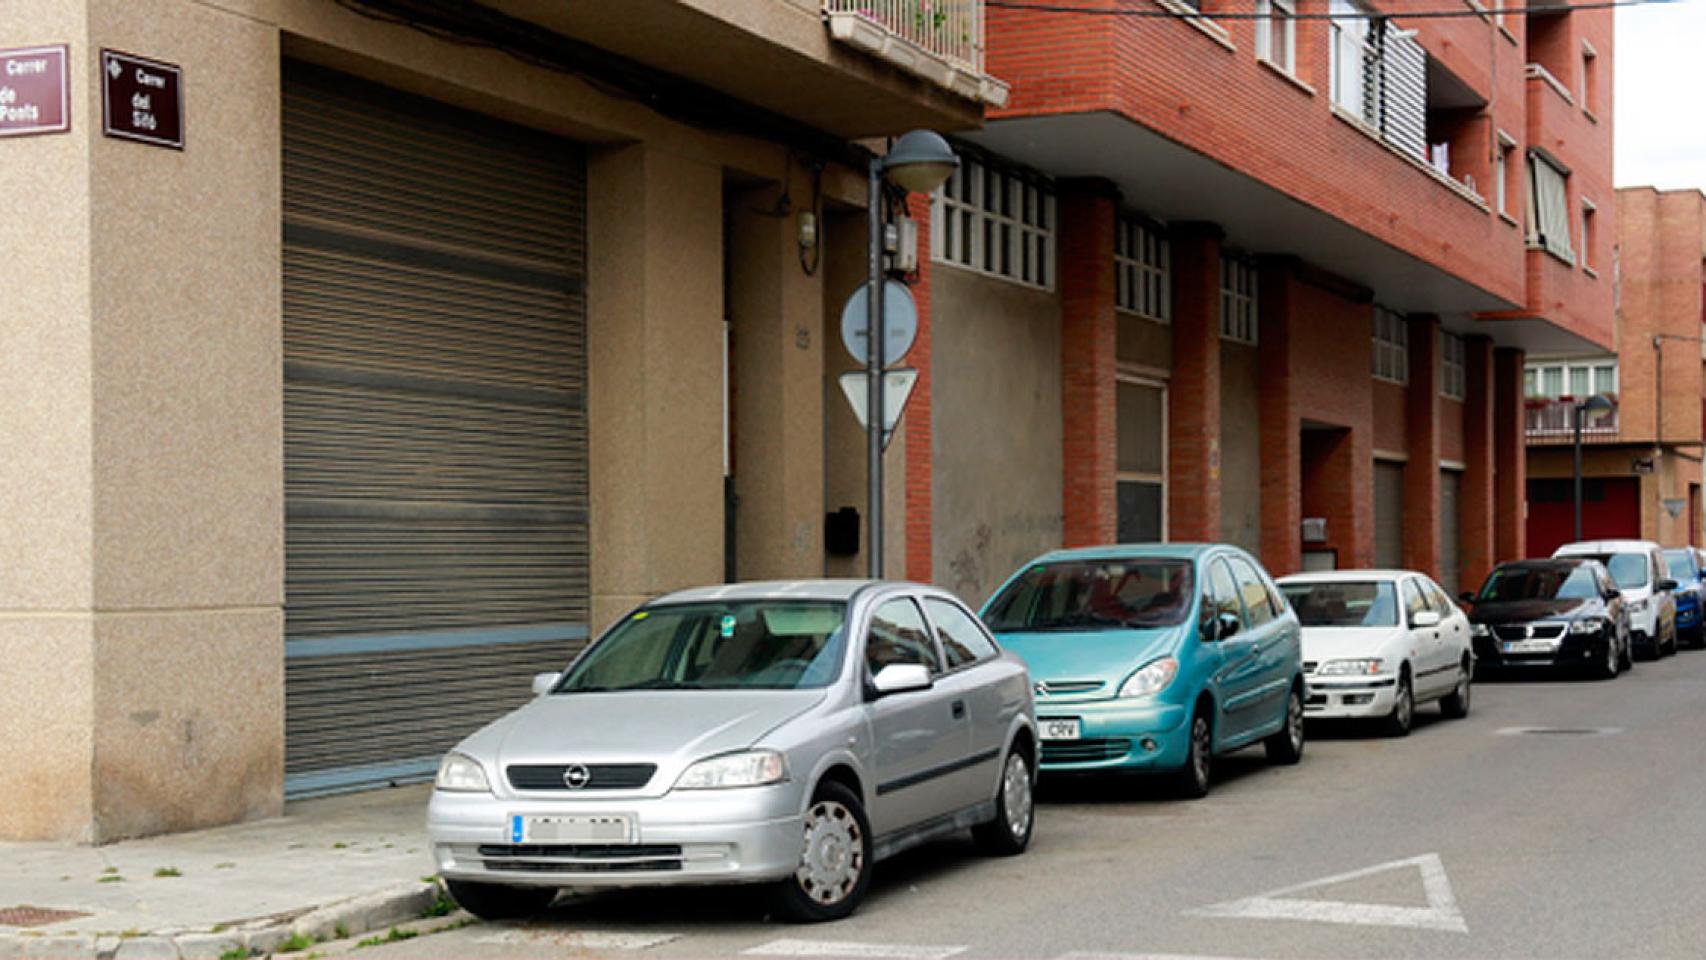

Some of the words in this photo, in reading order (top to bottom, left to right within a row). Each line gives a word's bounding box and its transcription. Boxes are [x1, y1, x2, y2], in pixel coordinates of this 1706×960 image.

[6, 59, 48, 76] Carrer
[132, 92, 151, 110] del
[0, 102, 38, 121] Ponts
